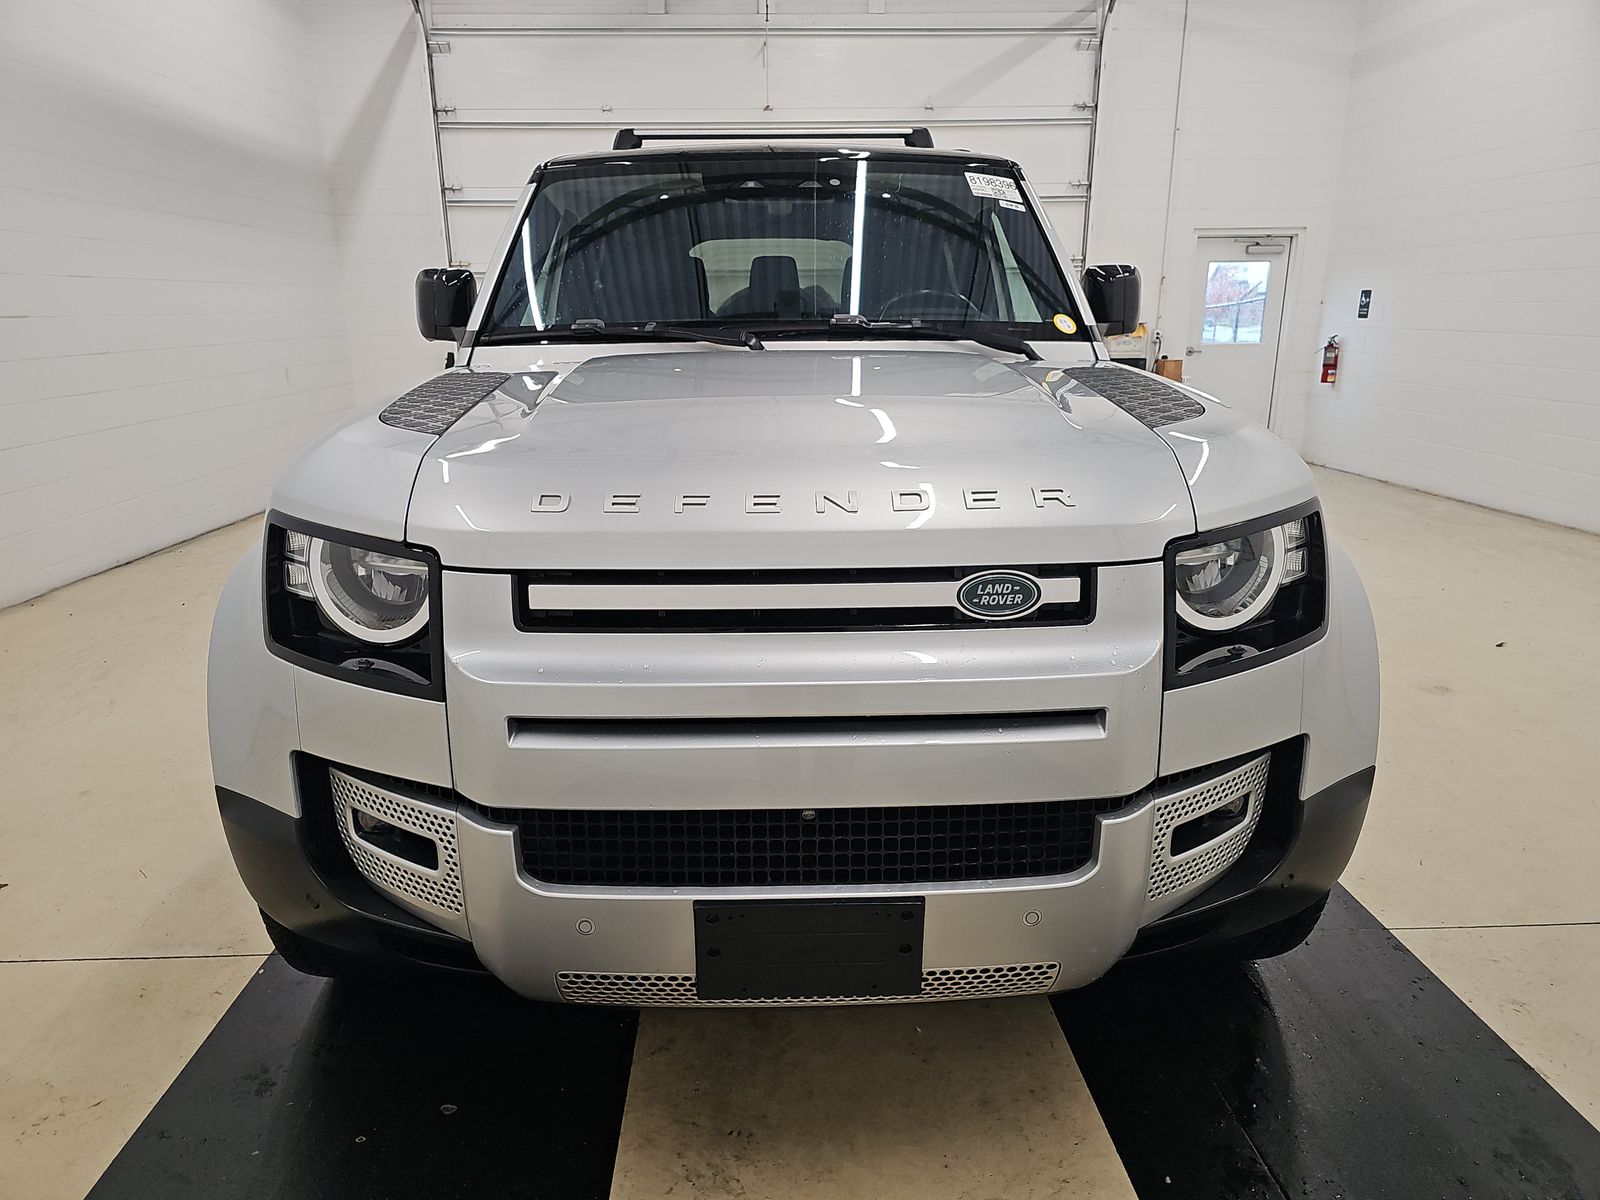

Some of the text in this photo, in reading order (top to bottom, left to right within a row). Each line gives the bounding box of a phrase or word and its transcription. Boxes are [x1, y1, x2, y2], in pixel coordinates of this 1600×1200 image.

[530, 487, 1076, 514] DEFENDER
[977, 583, 1012, 595] LAND
[980, 594, 1023, 606] ROVER
